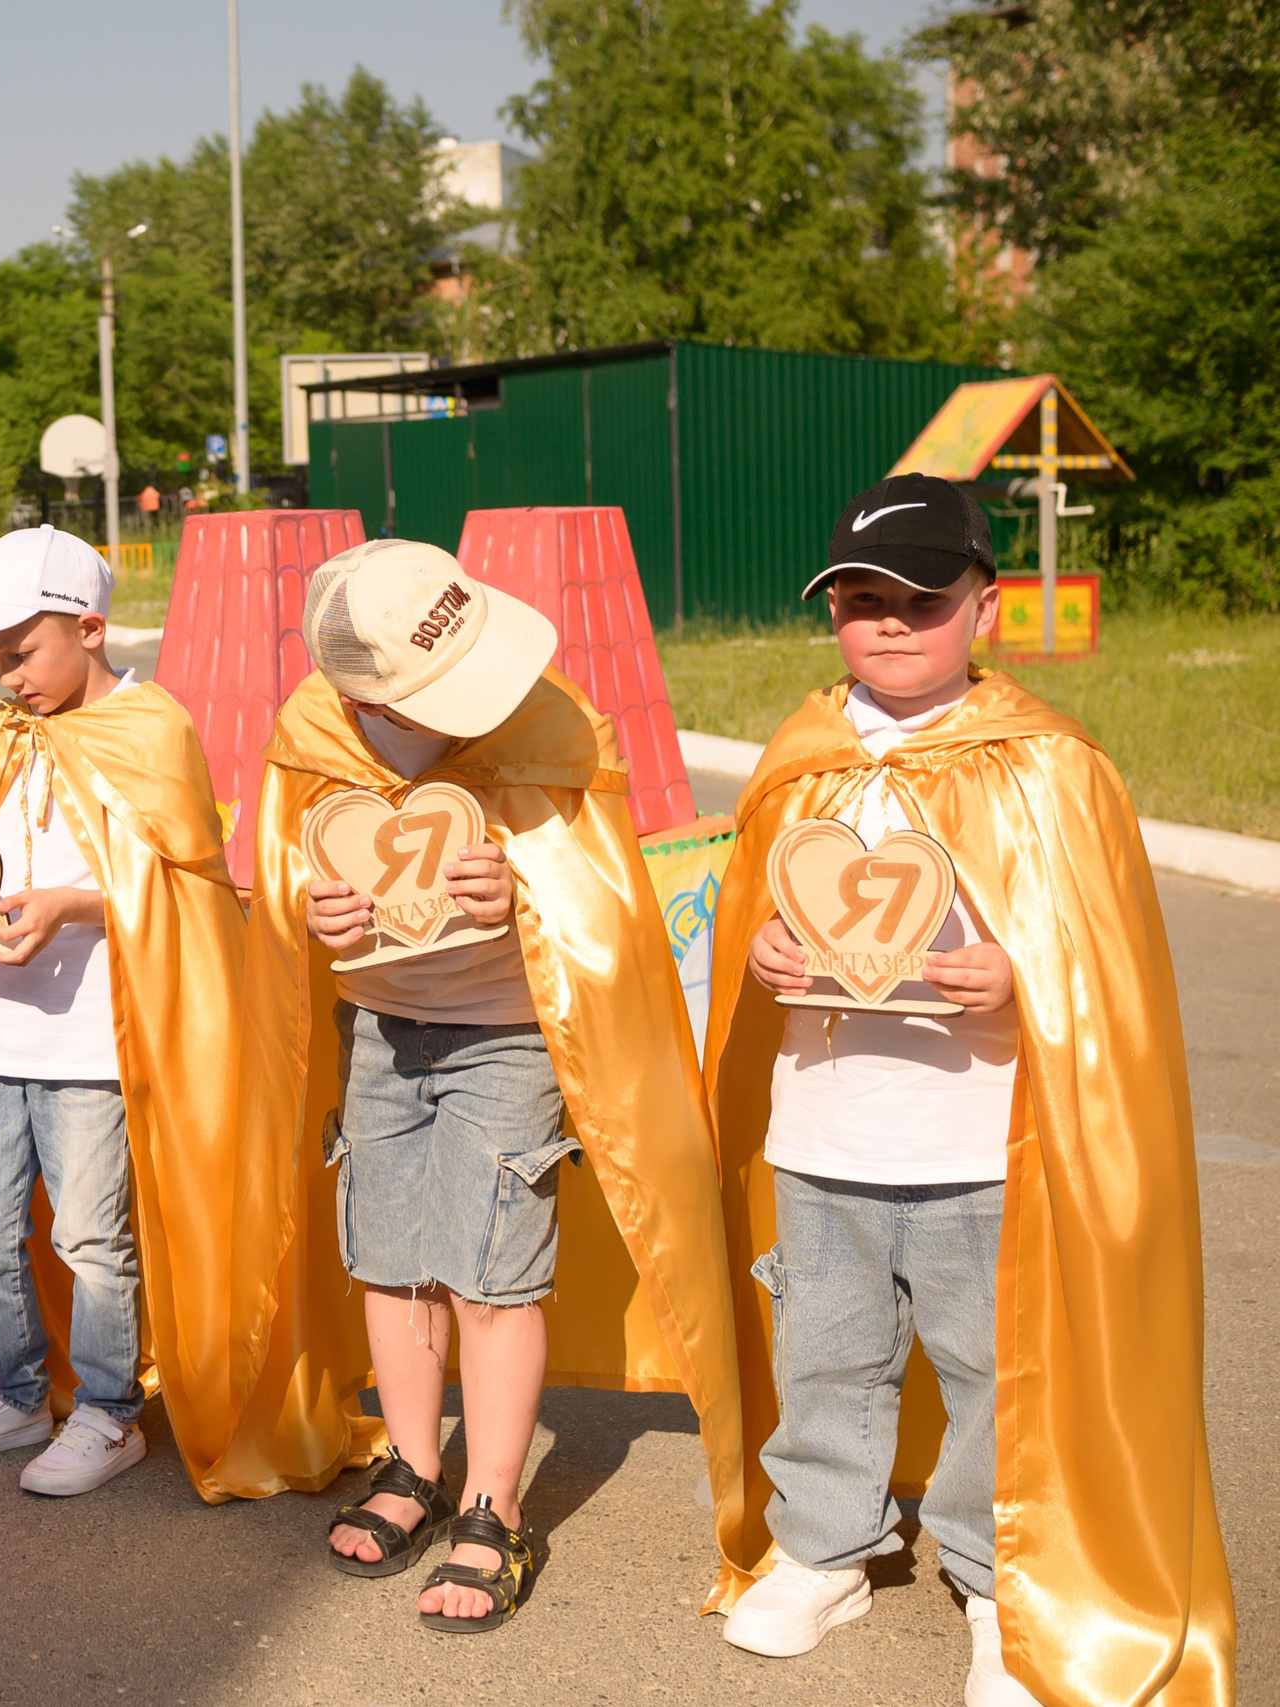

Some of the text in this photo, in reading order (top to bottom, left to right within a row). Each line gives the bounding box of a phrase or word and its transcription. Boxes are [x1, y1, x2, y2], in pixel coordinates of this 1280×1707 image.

[40, 590, 89, 608] Mercedes-Benz
[409, 581, 471, 652] BOSTON
[803, 950, 931, 977] АНТАЗЁР
